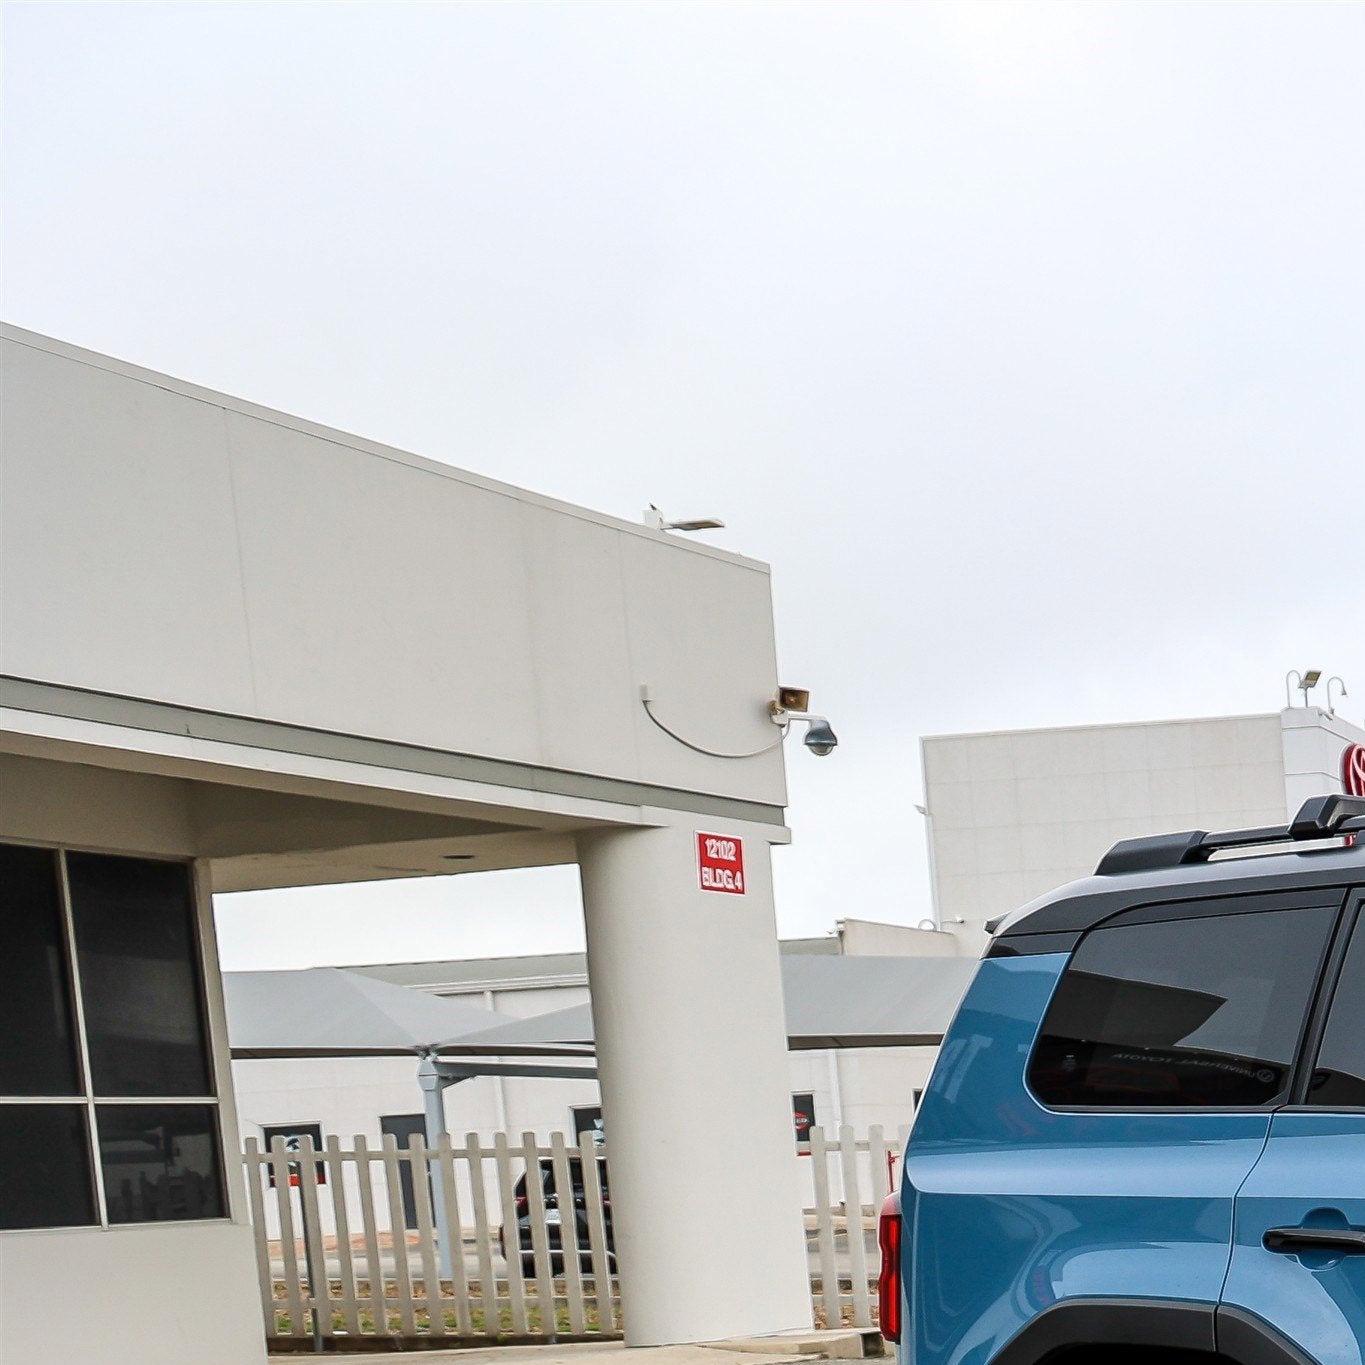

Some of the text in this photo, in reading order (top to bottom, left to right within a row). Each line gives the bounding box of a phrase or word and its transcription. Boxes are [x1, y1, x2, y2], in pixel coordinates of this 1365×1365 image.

[705, 838, 736, 861] 12102
[701, 866, 743, 890] BLDG 4
